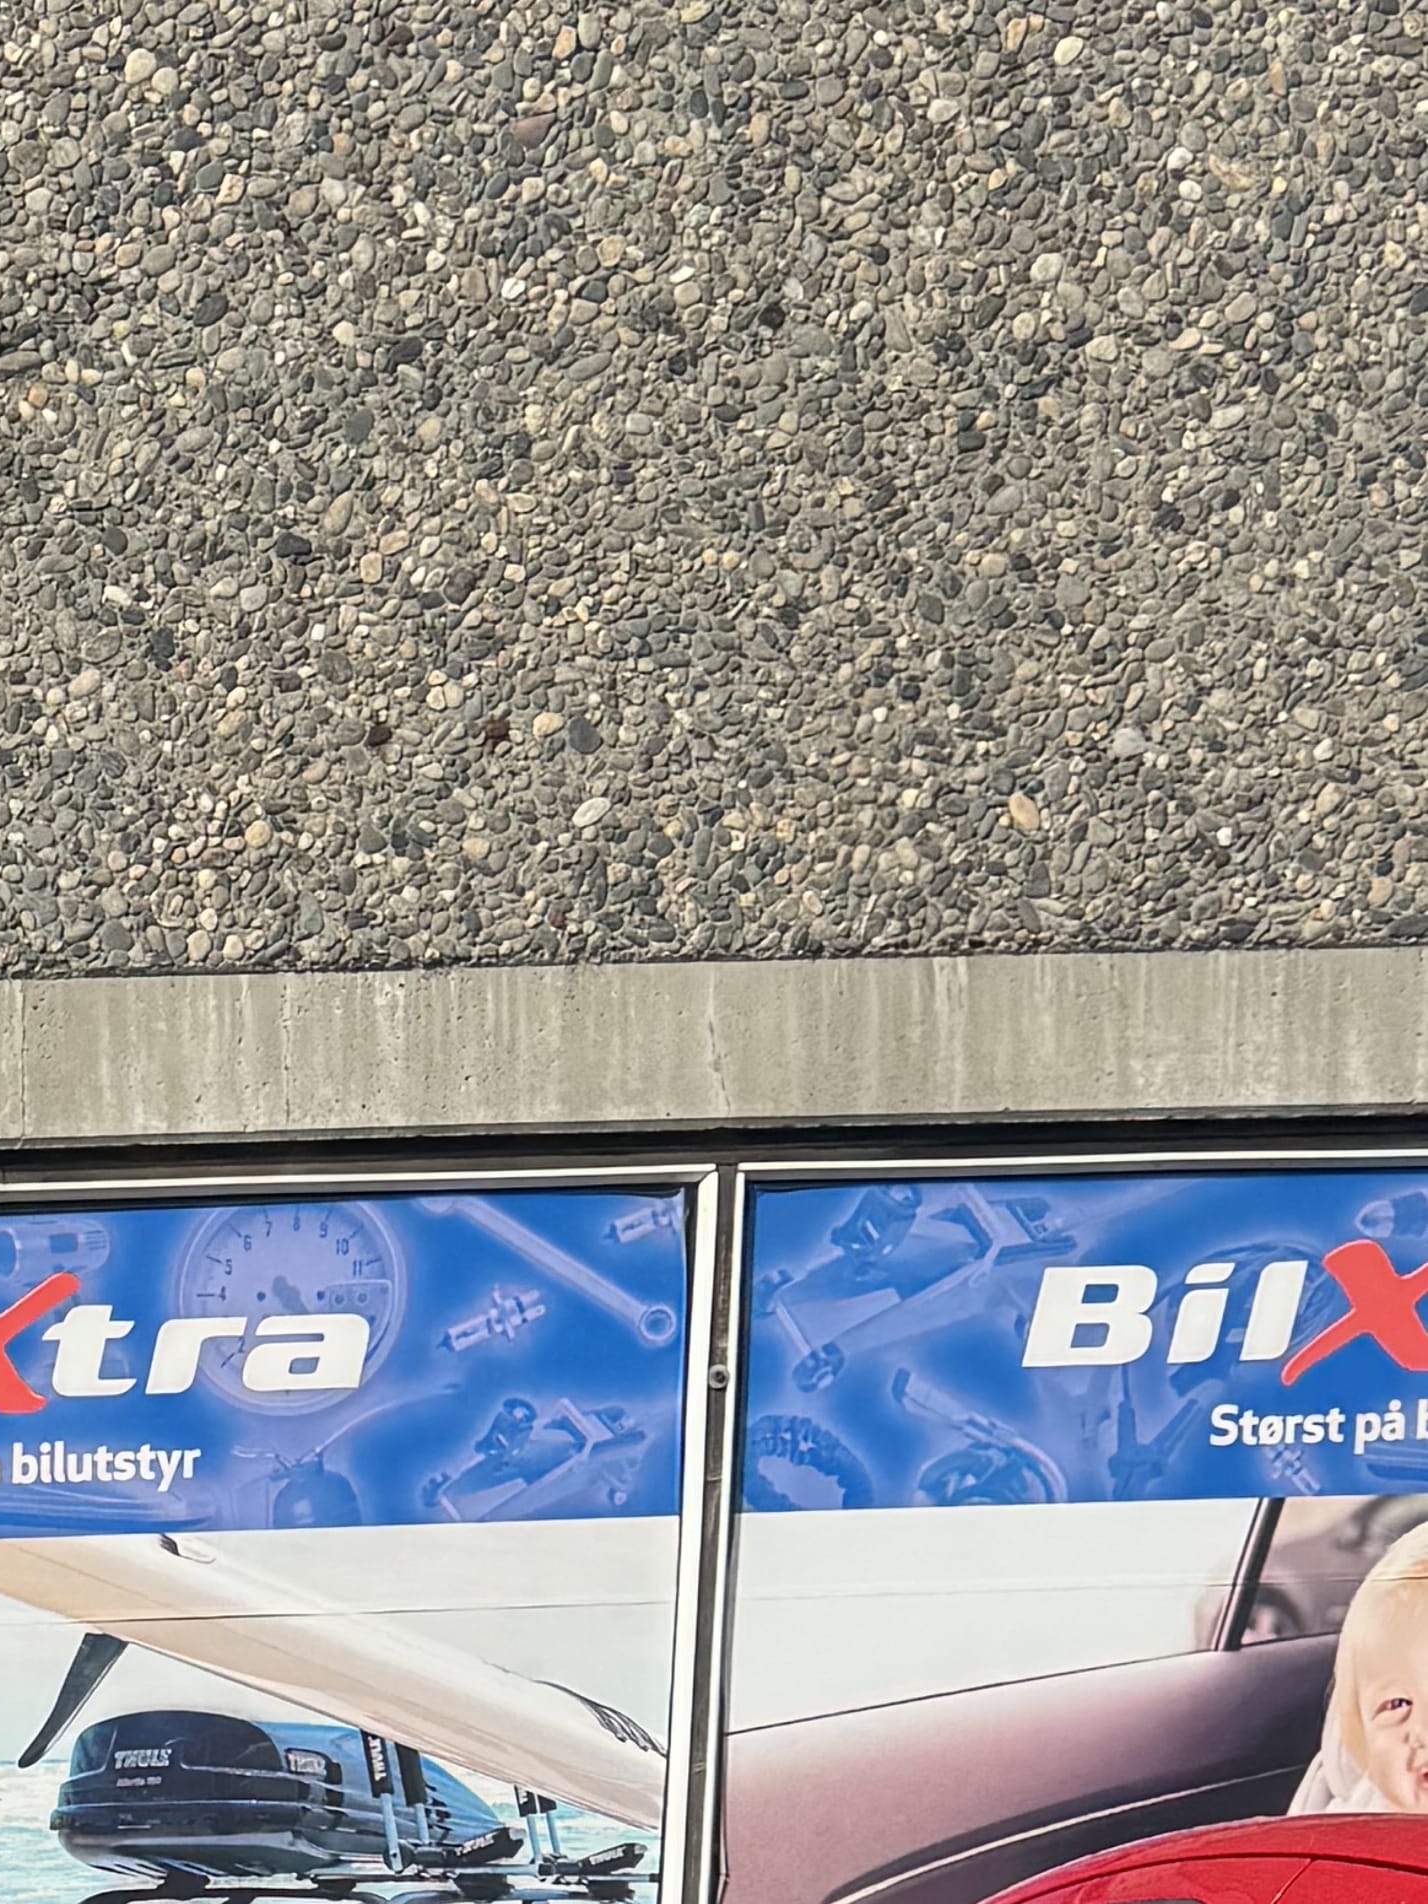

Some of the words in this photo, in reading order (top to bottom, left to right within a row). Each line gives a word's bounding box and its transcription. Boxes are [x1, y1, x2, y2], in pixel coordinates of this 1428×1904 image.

[336, 1238, 349, 1255] 10
[1209, 1404, 1345, 1446] Størst
[1354, 1399, 1406, 1455] på
[12, 1441, 202, 1492] bilutstyr
[113, 1748, 172, 1769] THULE
